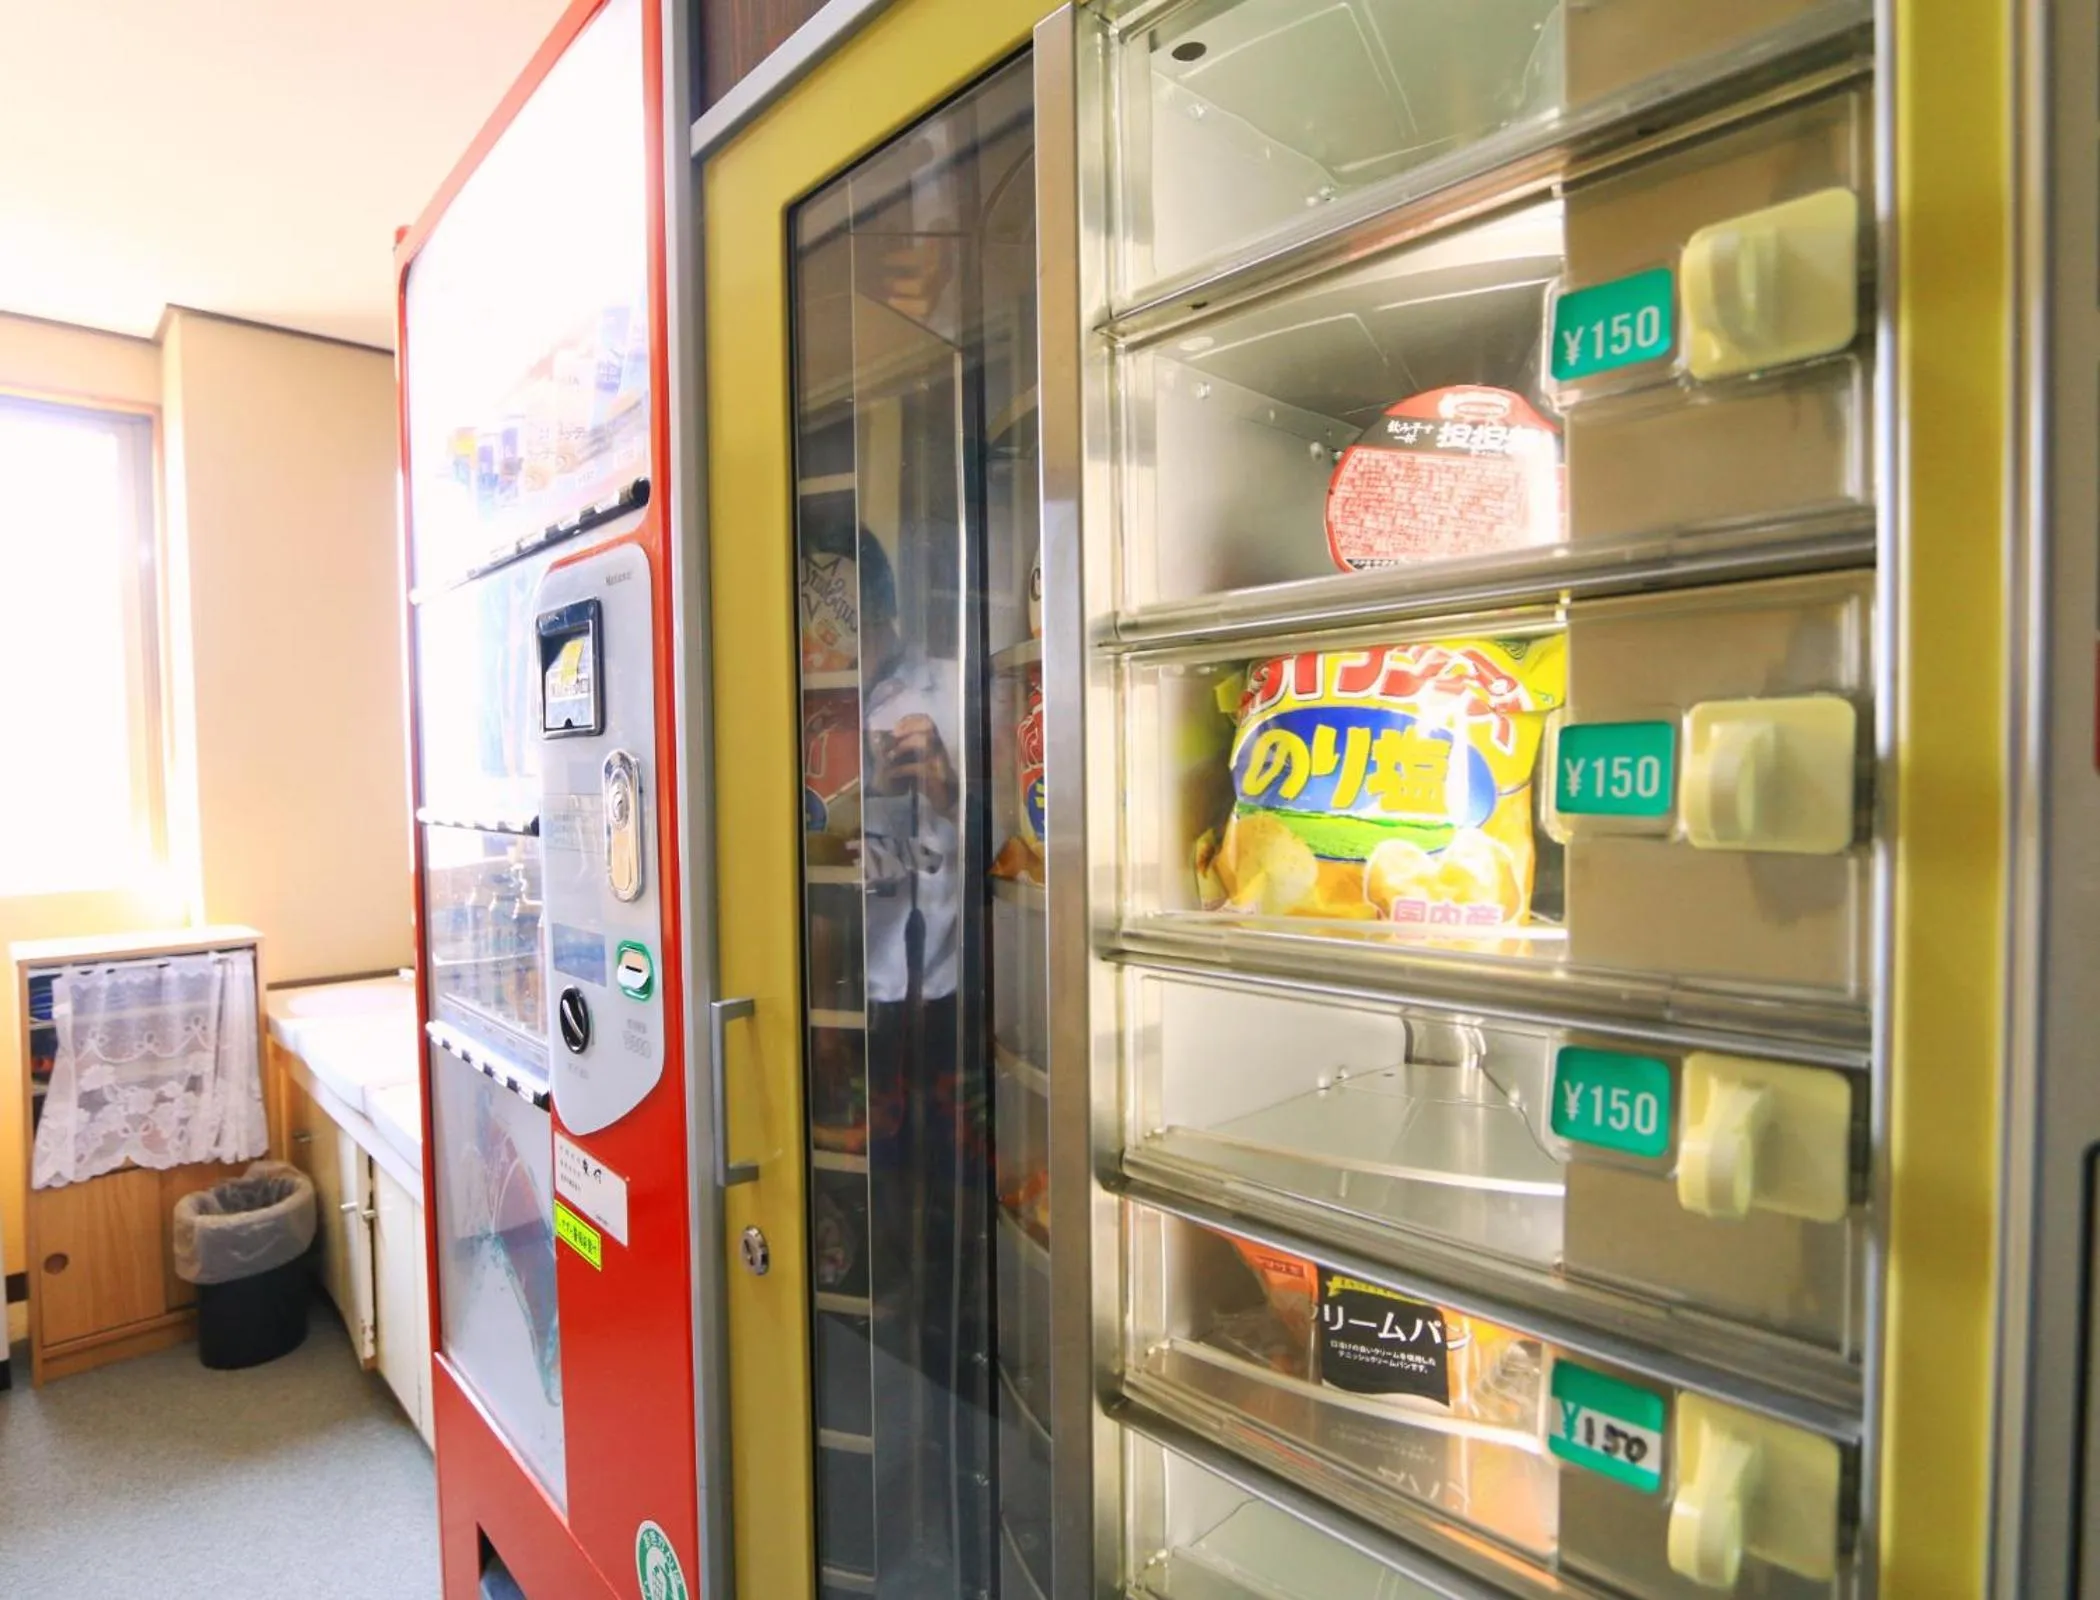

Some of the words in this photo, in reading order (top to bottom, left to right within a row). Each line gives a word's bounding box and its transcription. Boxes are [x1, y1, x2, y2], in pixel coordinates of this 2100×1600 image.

[1562, 304, 1661, 367] ¥150
[1435, 421, 1544, 453] 担担
[1241, 722, 1452, 813] のり塩
[1563, 754, 1661, 799] ¥150
[1562, 1079, 1659, 1136] ¥150
[1312, 1302, 1472, 1350] リームパン
